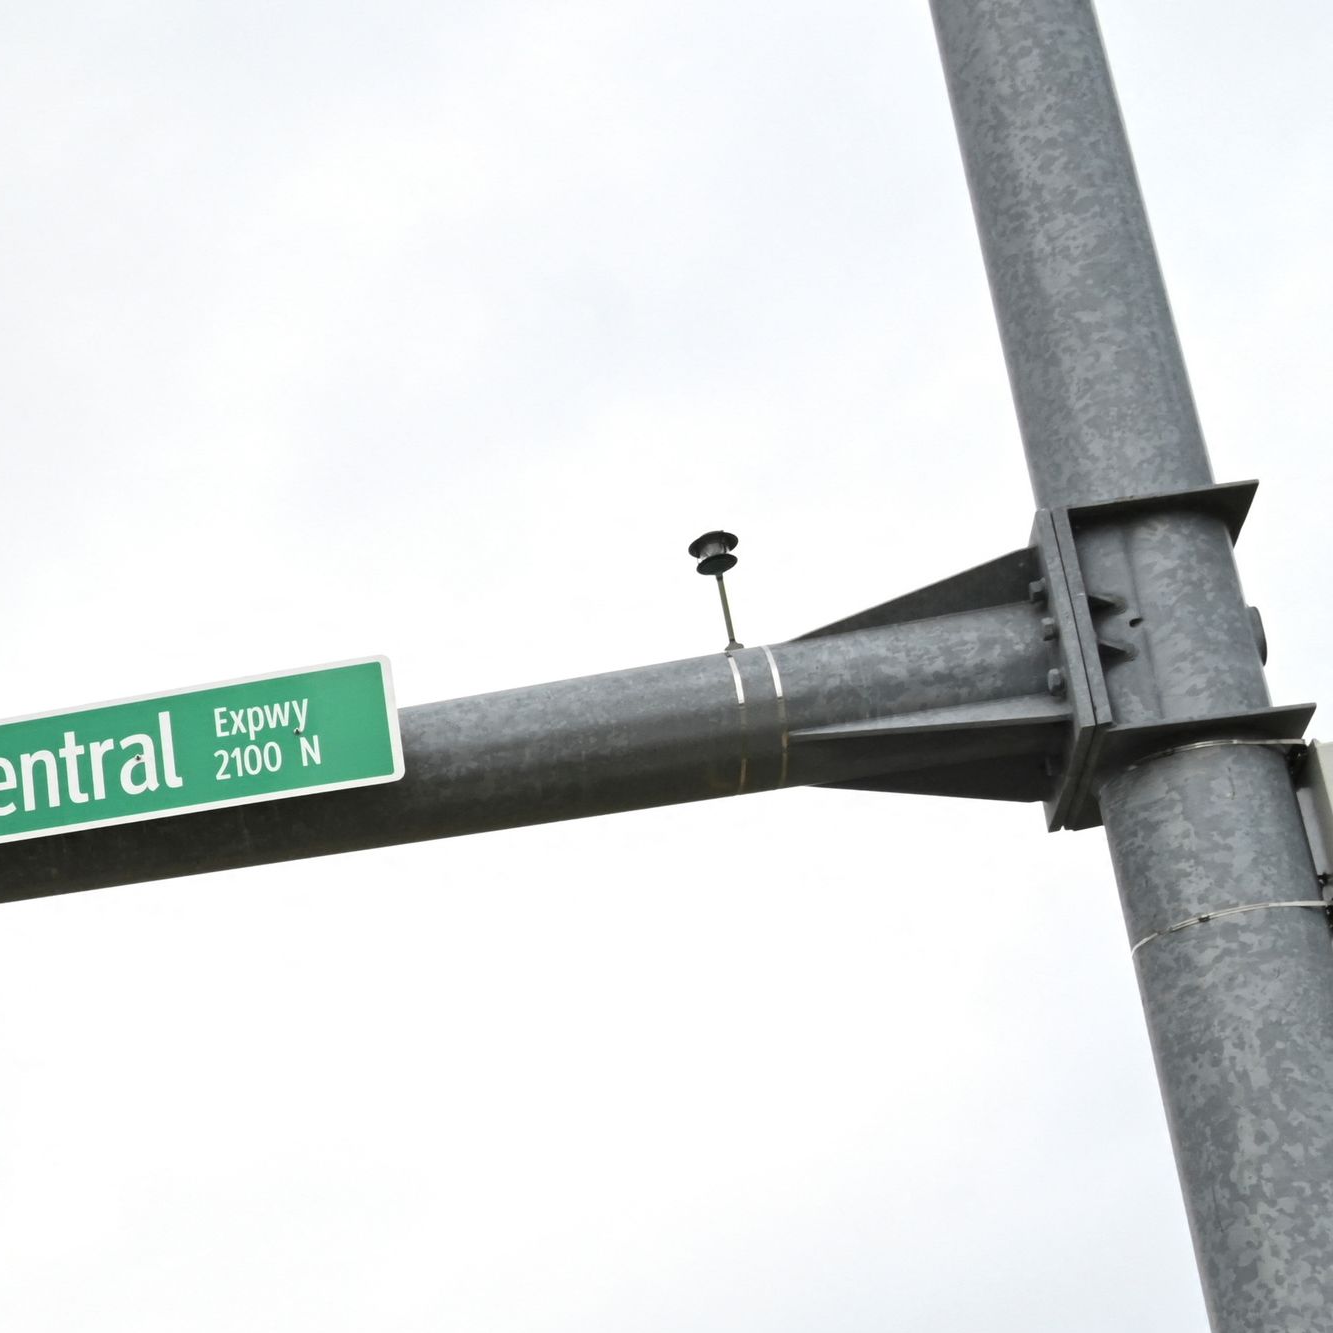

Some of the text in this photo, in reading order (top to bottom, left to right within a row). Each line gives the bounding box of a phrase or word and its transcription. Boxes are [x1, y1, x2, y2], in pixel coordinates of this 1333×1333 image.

[214, 698, 309, 742] Expwy
[214, 735, 322, 781] 2100 N
